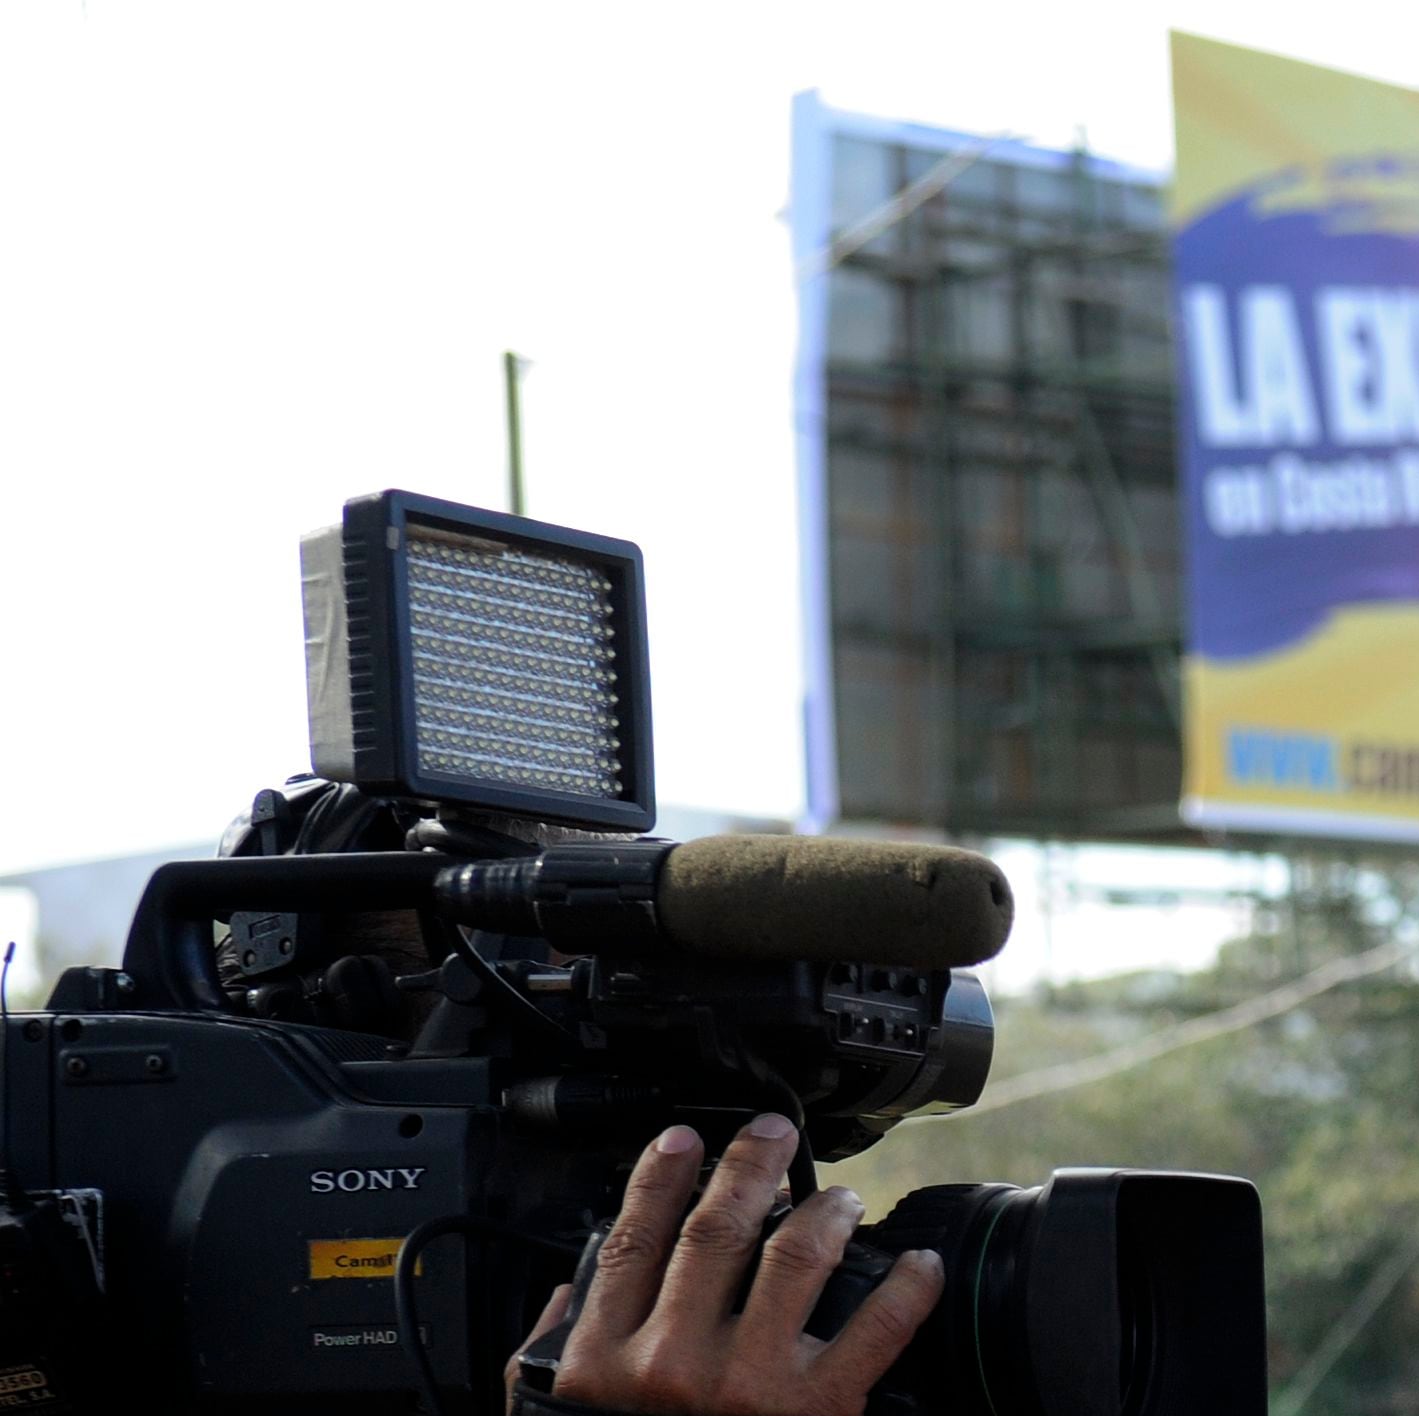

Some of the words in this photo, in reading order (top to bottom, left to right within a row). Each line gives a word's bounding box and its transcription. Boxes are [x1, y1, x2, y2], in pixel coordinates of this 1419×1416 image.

[1186, 287, 1316, 446] LA
[1208, 468, 1264, 536] en
[1270, 457, 1388, 532] Costa
[310, 1167, 426, 1193] SONY
[313, 1332, 361, 1347] Power
[362, 1330, 398, 1345] HAD
